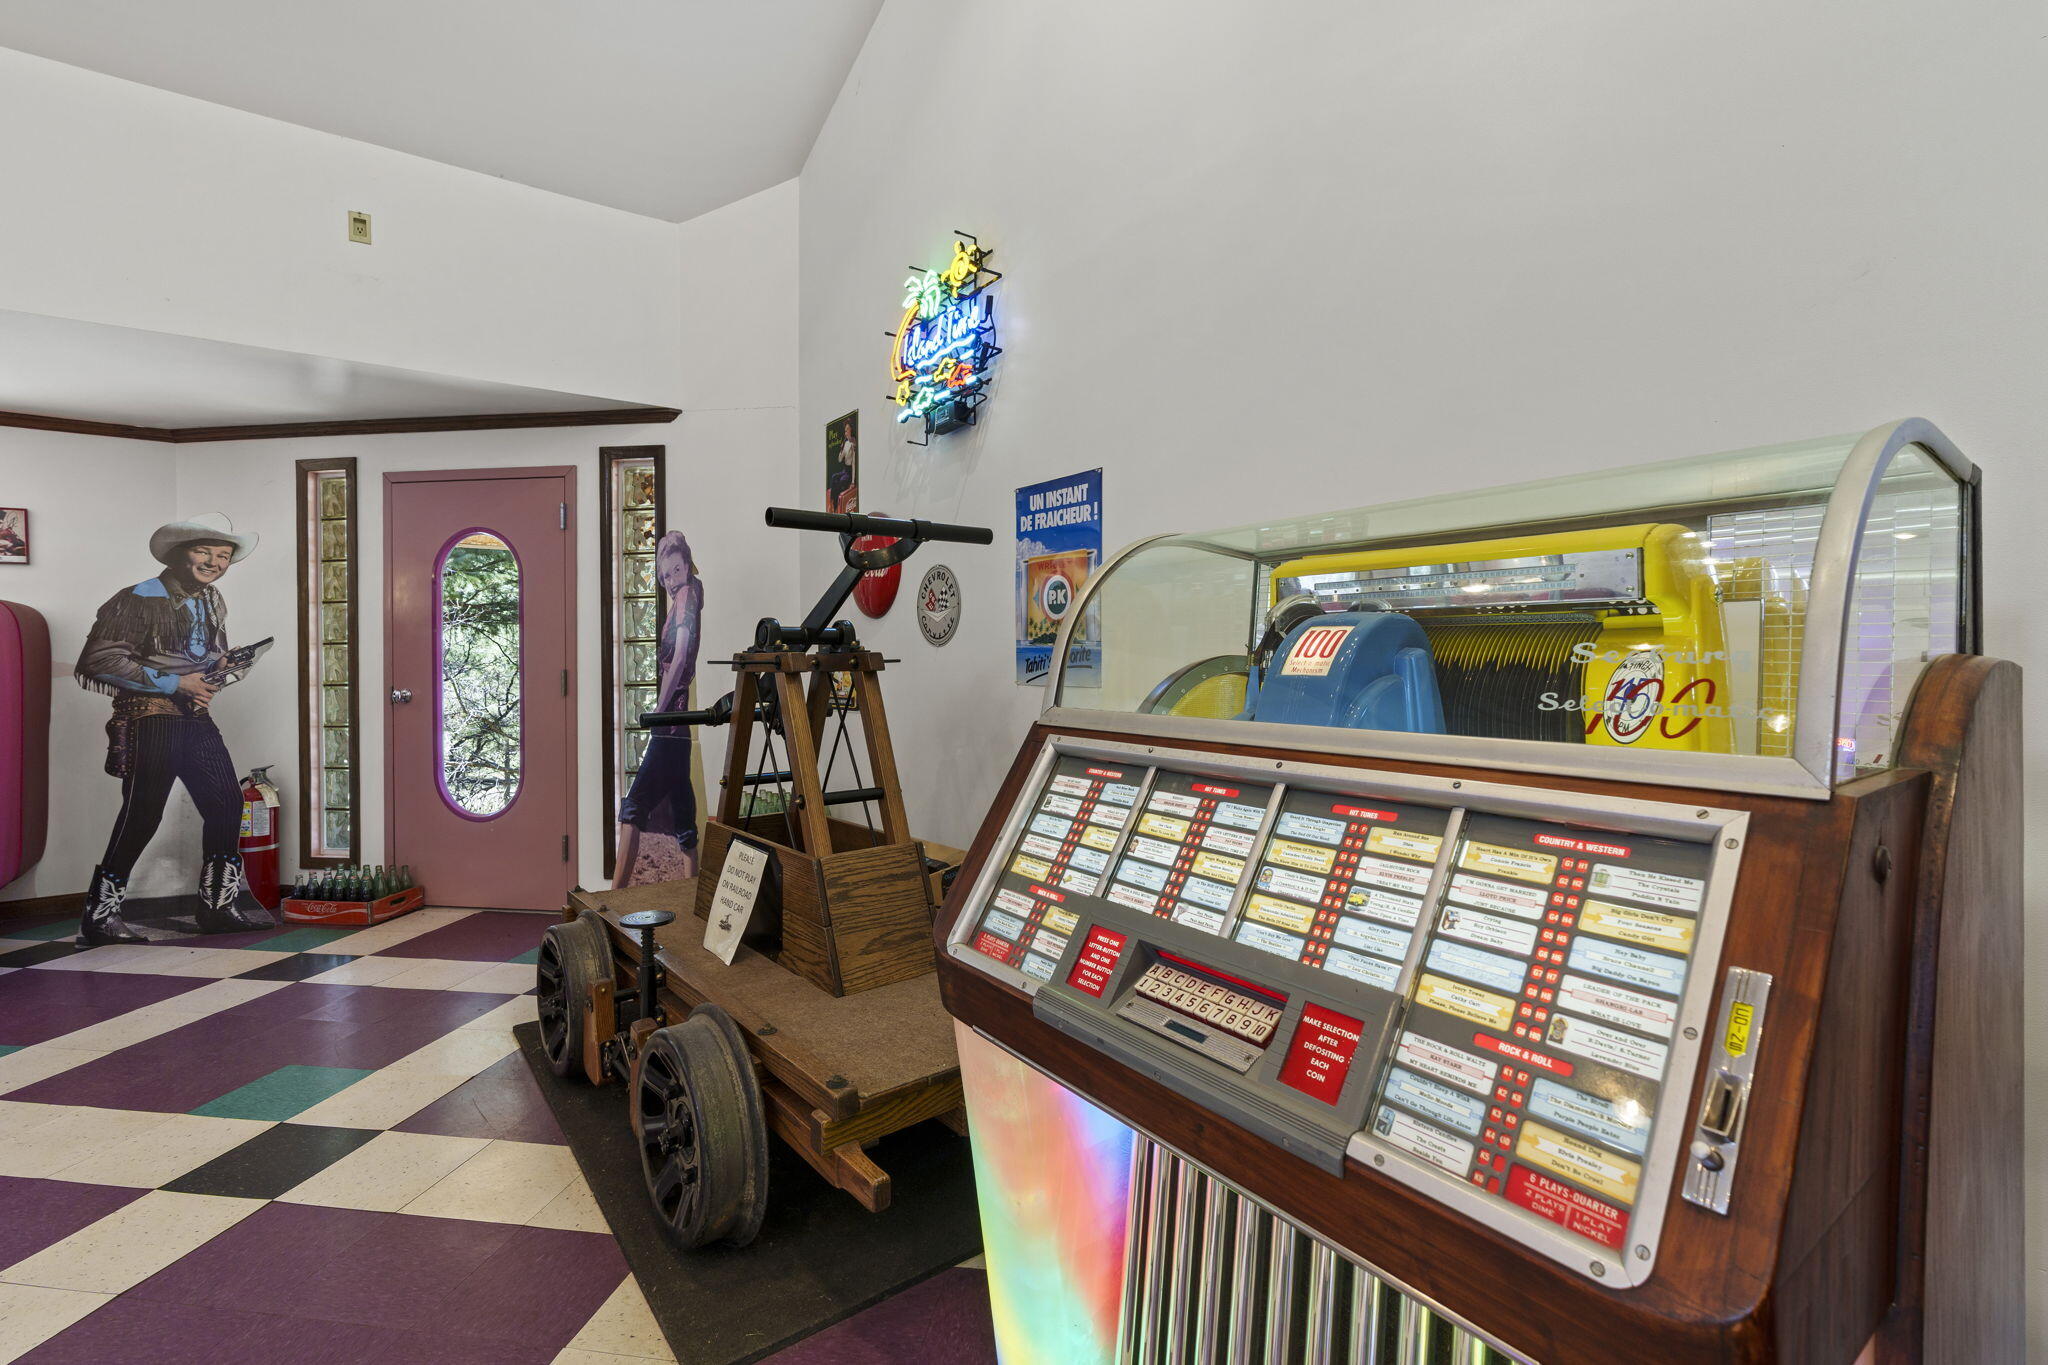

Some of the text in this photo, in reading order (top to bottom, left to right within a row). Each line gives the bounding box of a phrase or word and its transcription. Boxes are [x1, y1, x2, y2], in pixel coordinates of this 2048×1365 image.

[903, 306, 981, 366] Island Time
[1029, 483, 1088, 511] UN INSTANT
[1020, 516, 1033, 532] DE
[1035, 504, 1092, 531] FRAICHEUR
[921, 571, 956, 600] CHEVROLET
[922, 615, 955, 640] Corvette
[1294, 629, 1348, 658] 100
[1213, 787, 1226, 795] TUNES
[1349, 809, 1379, 820] HIT TUNES
[1539, 835, 1626, 857] COUNTRY & WESTERN
[739, 851, 755, 866] PLEASE
[727, 864, 756, 884] DO NOT PLAY
[721, 879, 752, 901] ON RAILROAD
[306, 902, 338, 913] Coca-Cola
[720, 895, 744, 915] HAND CAR
[1088, 941, 1121, 958] LETTER-BUTTON
[1097, 935, 1119, 948] PRESS ONE
[1080, 957, 1098, 970] NUMBER
[1091, 952, 1111, 965] AND ONE
[1077, 977, 1101, 992] SELECTION
[1082, 969, 1103, 982] FOR EACH
[1150, 965, 1160, 976] A
[1163, 969, 1172, 980] B
[1175, 973, 1184, 984] C
[1186, 978, 1196, 989] D
[1198, 983, 1208, 994] E
[1211, 987, 1221, 999] F
[1224, 993, 1234, 1005] G
[1252, 1003, 1262, 1016] J
[1266, 1009, 1278, 1022] K
[1139, 978, 1265, 1037] 1 2 3 4 5 6 7 8 9 10
[1303, 1015, 1360, 1042] MAKE SELECTION
[1318, 1034, 1339, 1048] AFTER
[1303, 1042, 1346, 1064] DEPOSITING
[1498, 1043, 1553, 1069] ROCK & ROLL
[1310, 1057, 1330, 1071] EACH
[1306, 1069, 1326, 1084] COIN
[1529, 1172, 1537, 1184] 6
[1525, 1189, 1565, 1212] 2 PLAYS
[1531, 1201, 1555, 1218] DIME
[1572, 1220, 1611, 1244] NICKEL
[1582, 1215, 1612, 1233] PLAY
